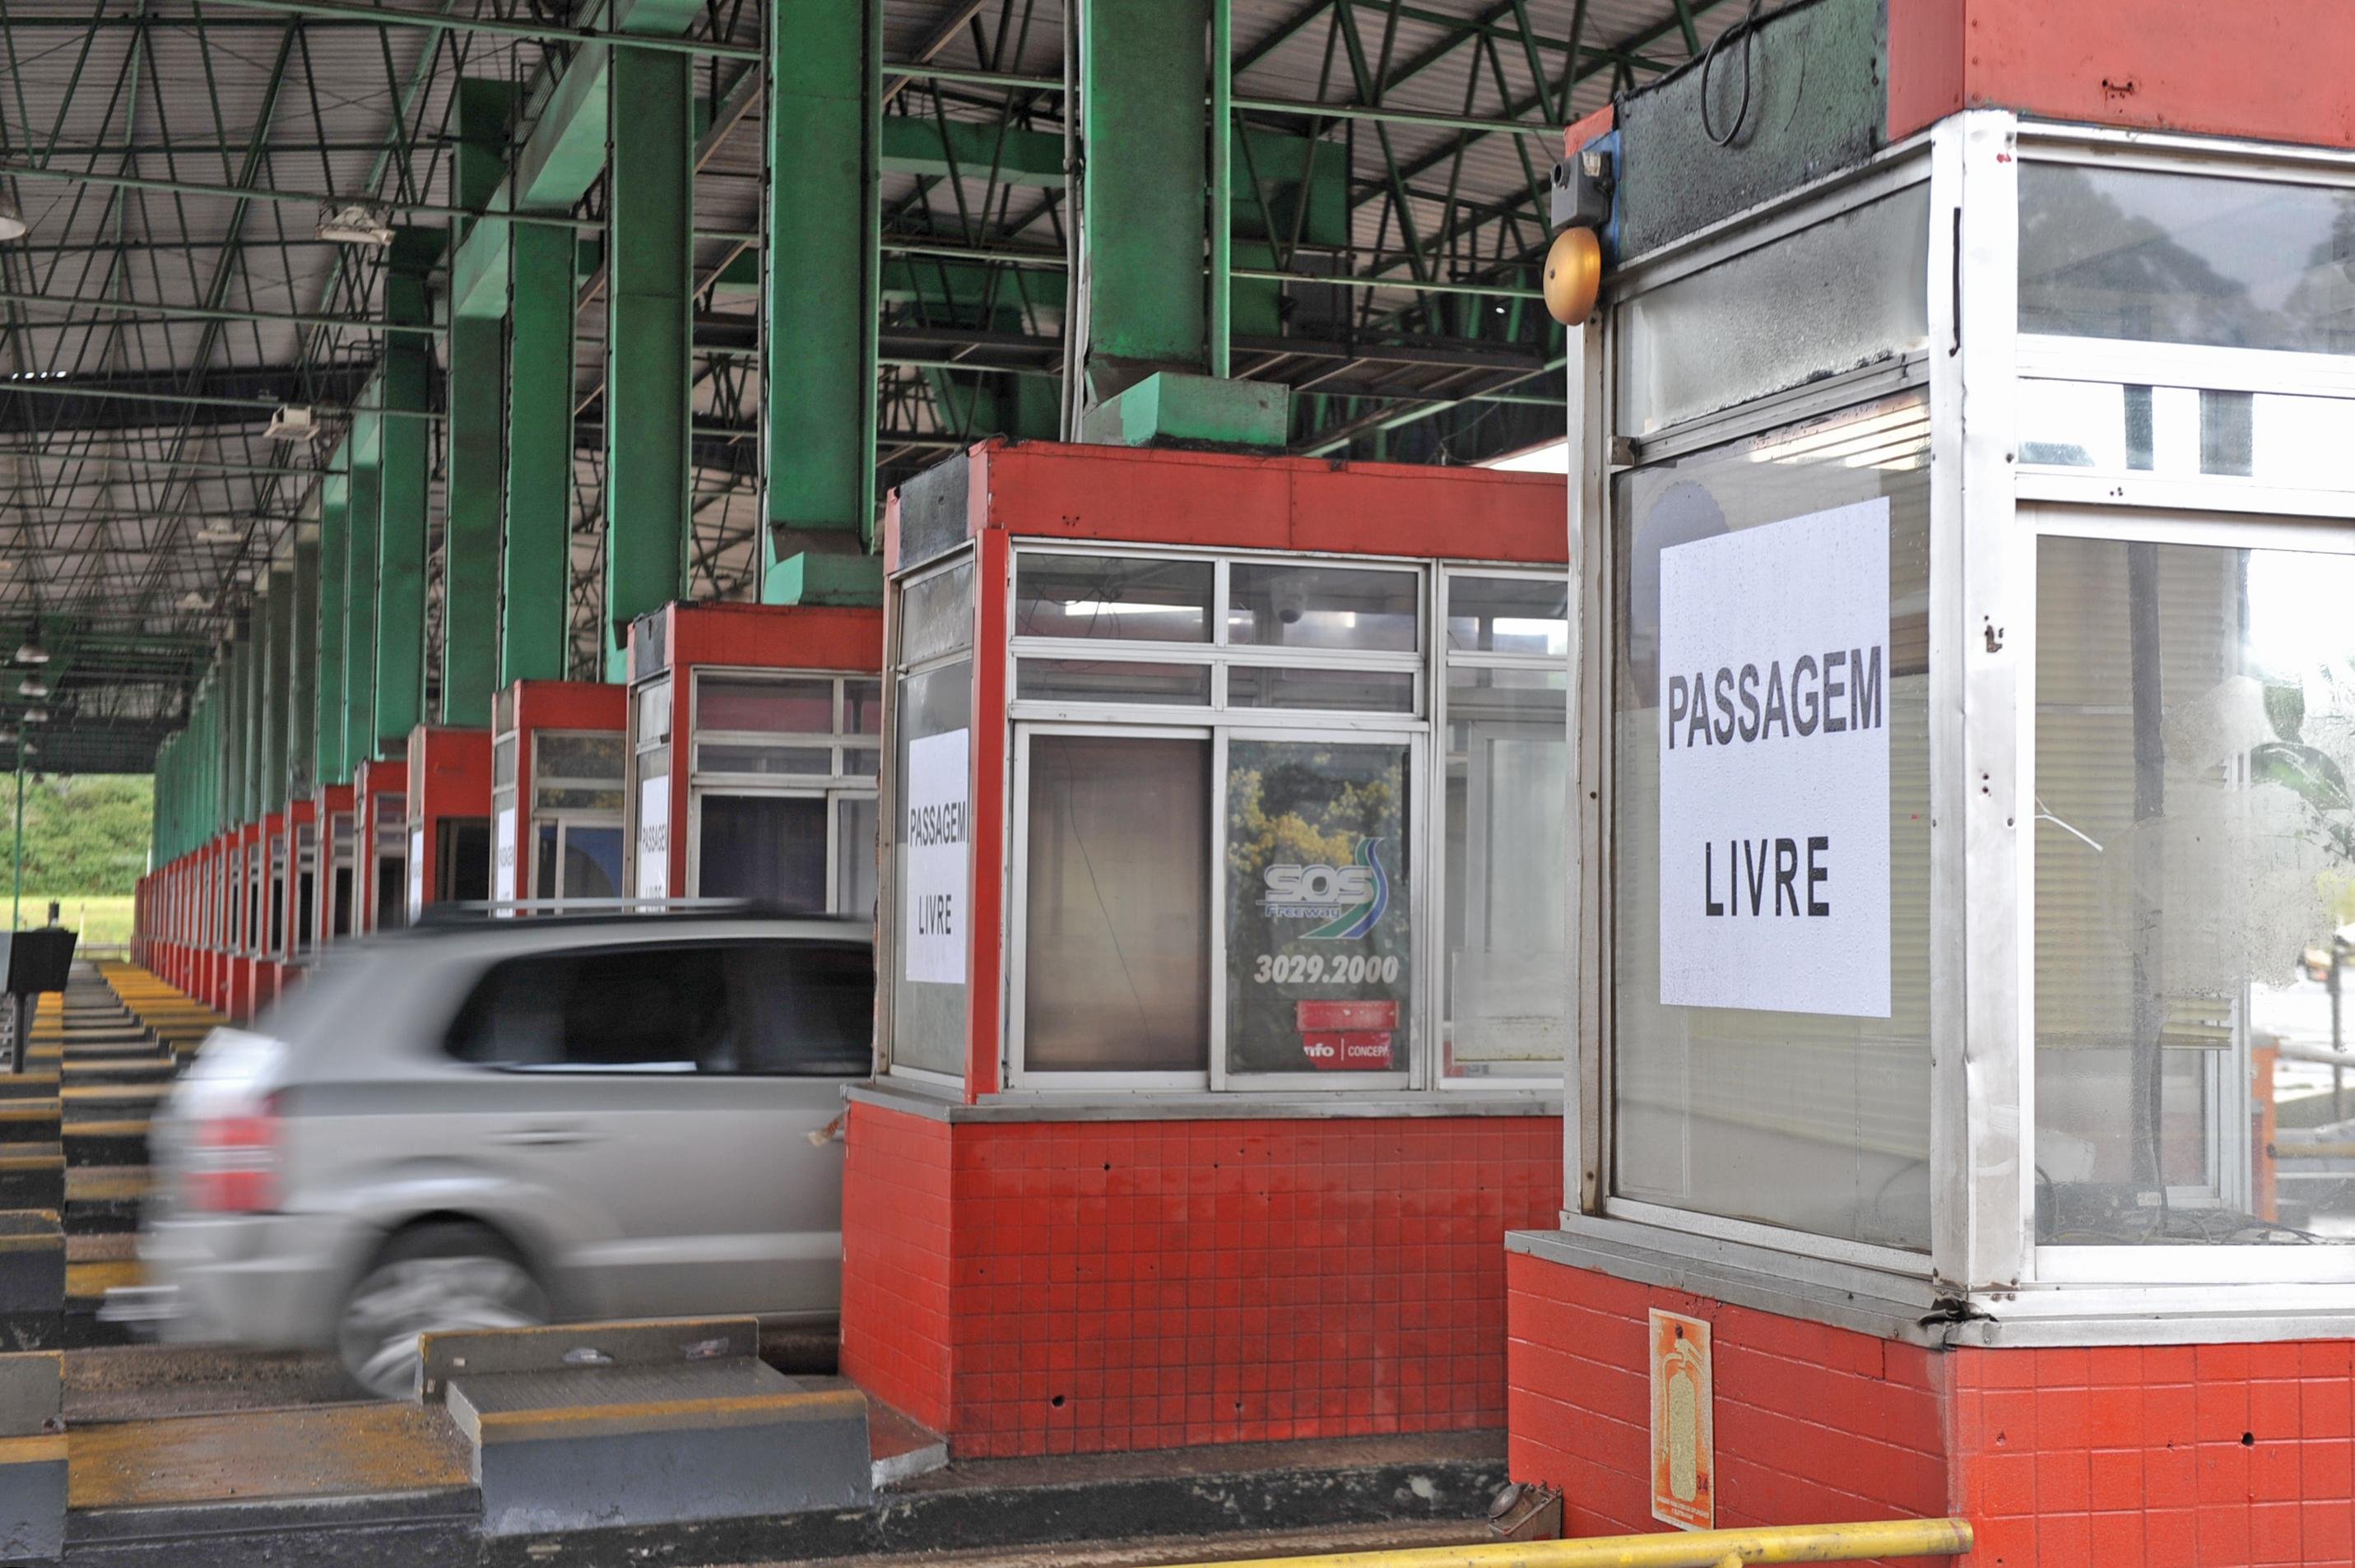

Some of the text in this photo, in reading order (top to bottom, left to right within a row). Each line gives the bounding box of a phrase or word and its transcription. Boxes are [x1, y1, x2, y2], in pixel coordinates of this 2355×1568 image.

[1669, 646, 1881, 749] PASSAGEM
[643, 824, 667, 853] PASSAGE
[910, 801, 965, 847] PASSAGEM
[1264, 864, 1374, 904] SOS
[1706, 837, 1829, 916] LIVRE
[919, 894, 951, 935] LIVRE
[1265, 905, 1342, 919] Freeway
[1254, 954, 1400, 984] 3029.2000
